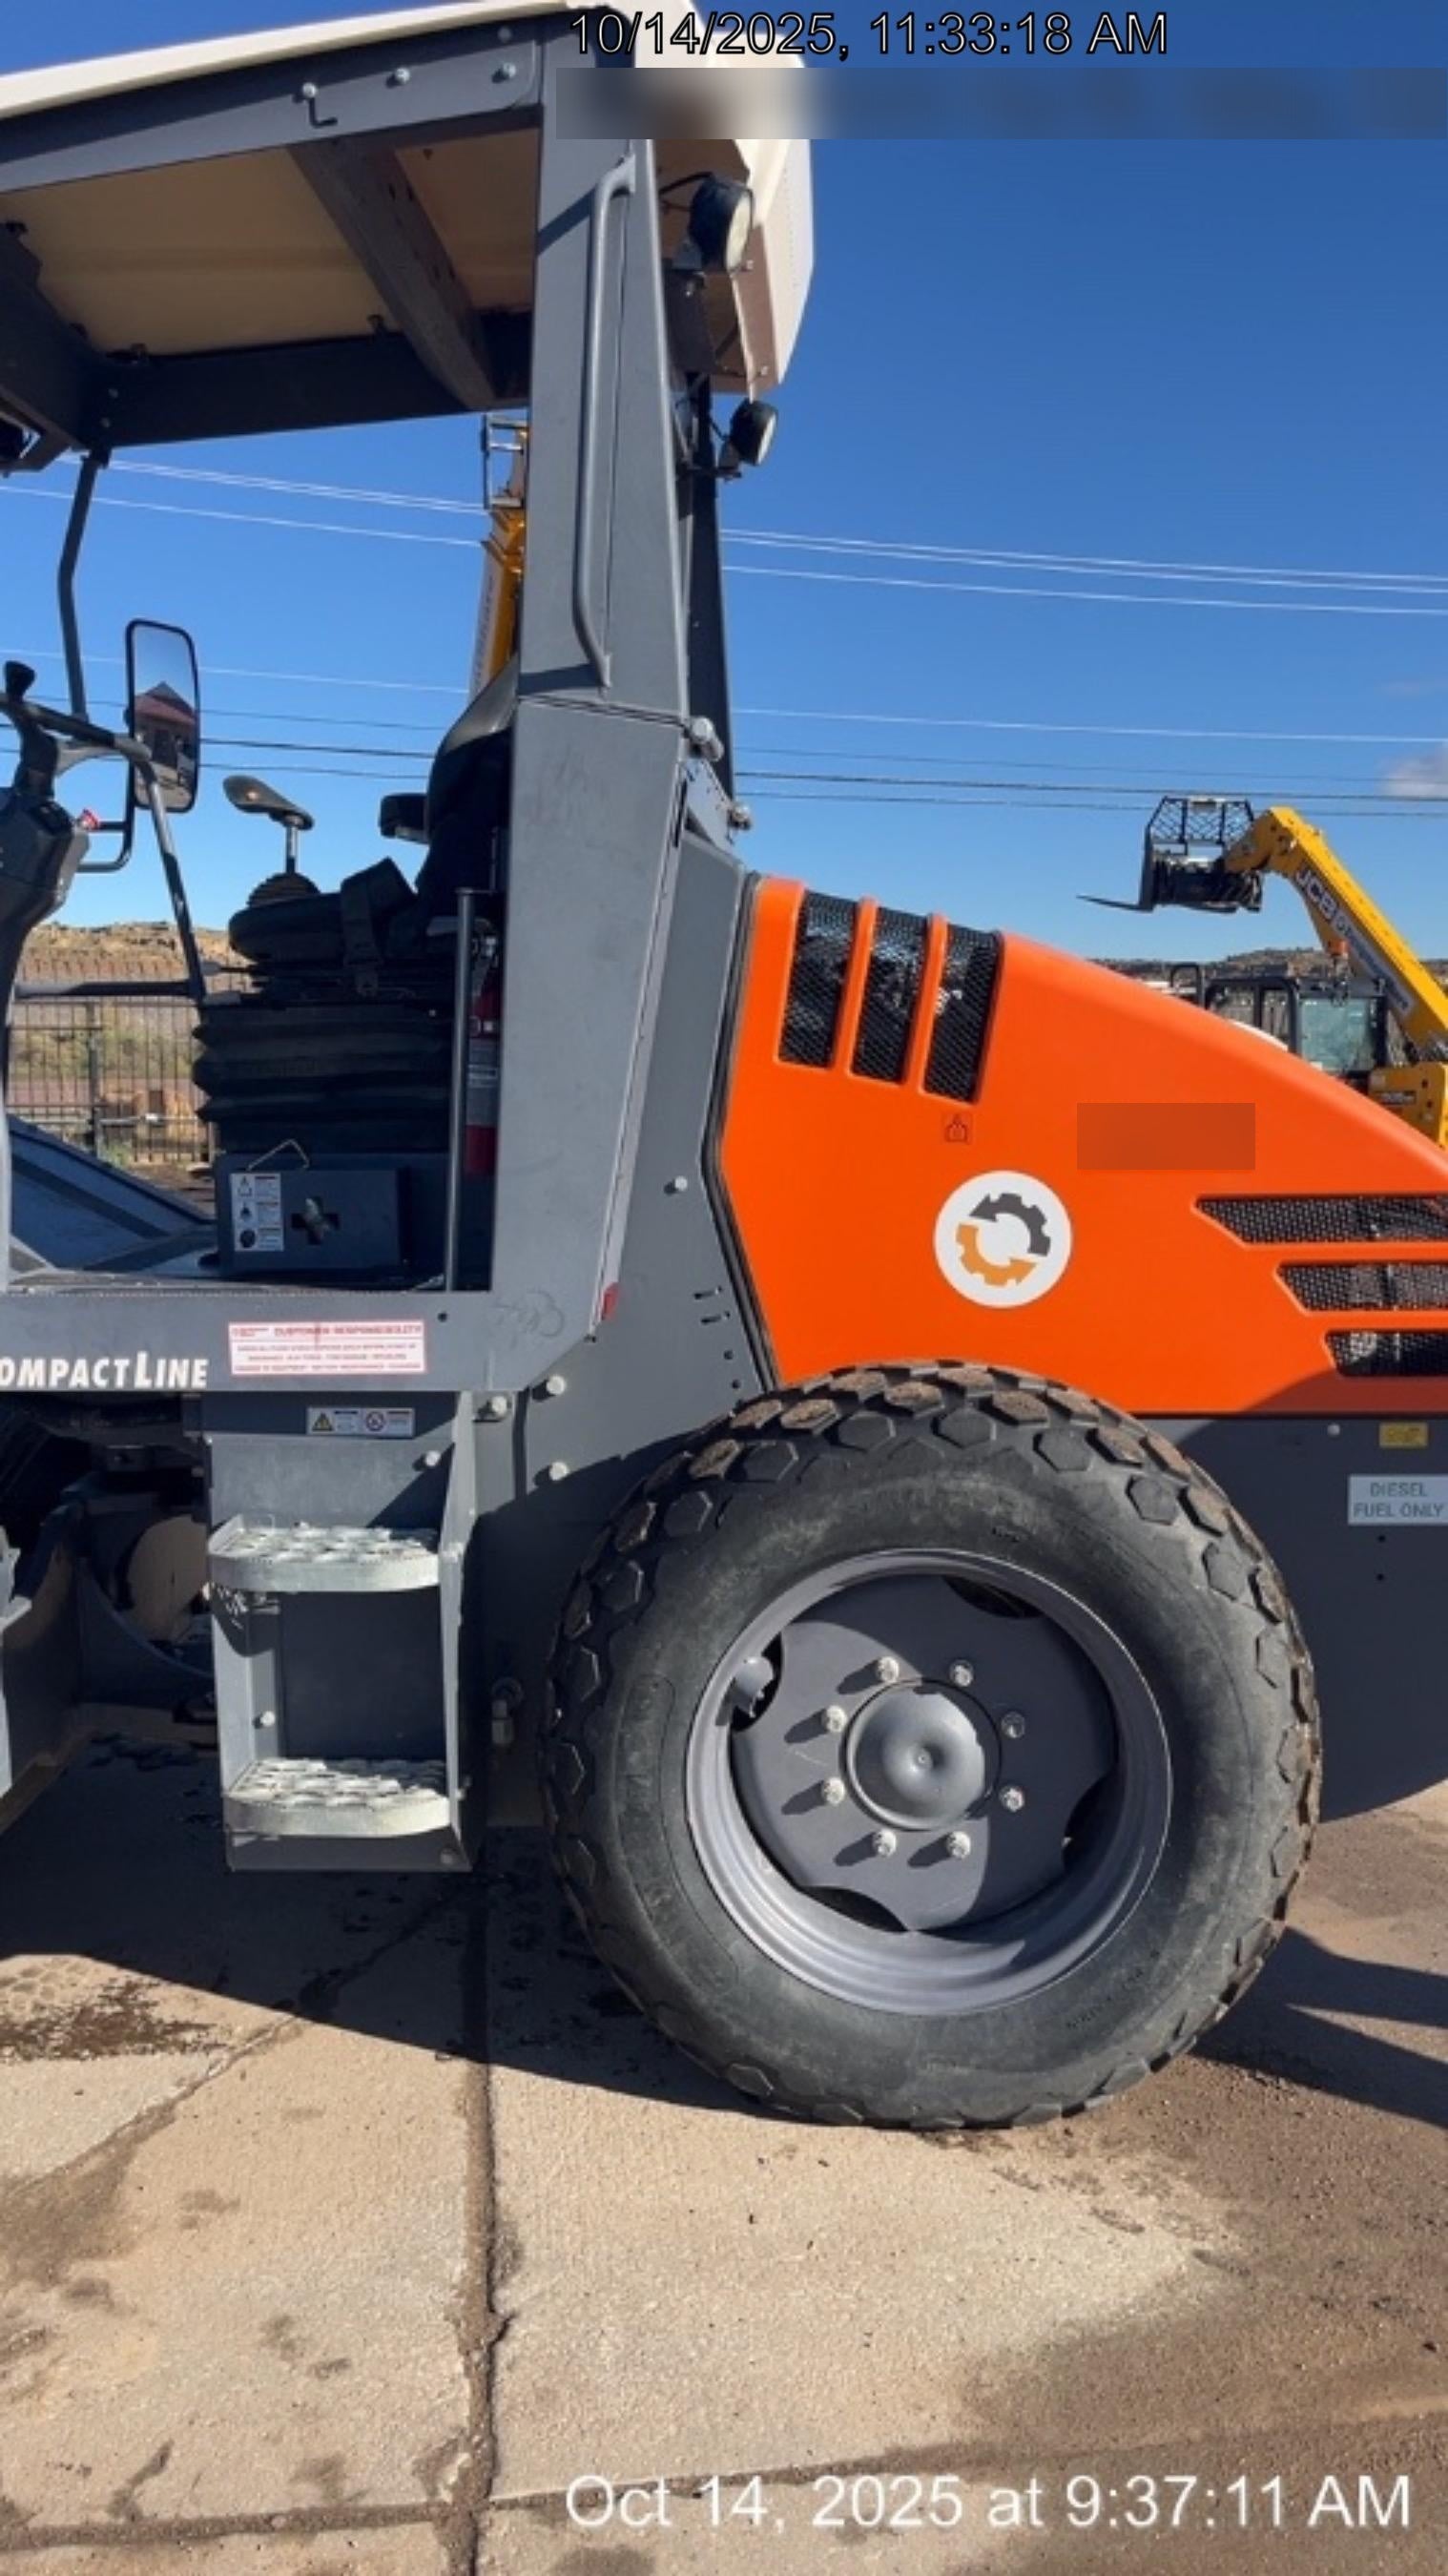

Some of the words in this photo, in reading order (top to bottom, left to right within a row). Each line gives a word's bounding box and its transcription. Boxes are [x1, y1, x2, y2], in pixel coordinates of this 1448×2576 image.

[1295, 869, 1337, 921] JCB
[1370, 1481, 1428, 1497] DIESEL
[1353, 1503, 1396, 1518] FUEL
[1399, 1503, 1445, 1518] ONLY
